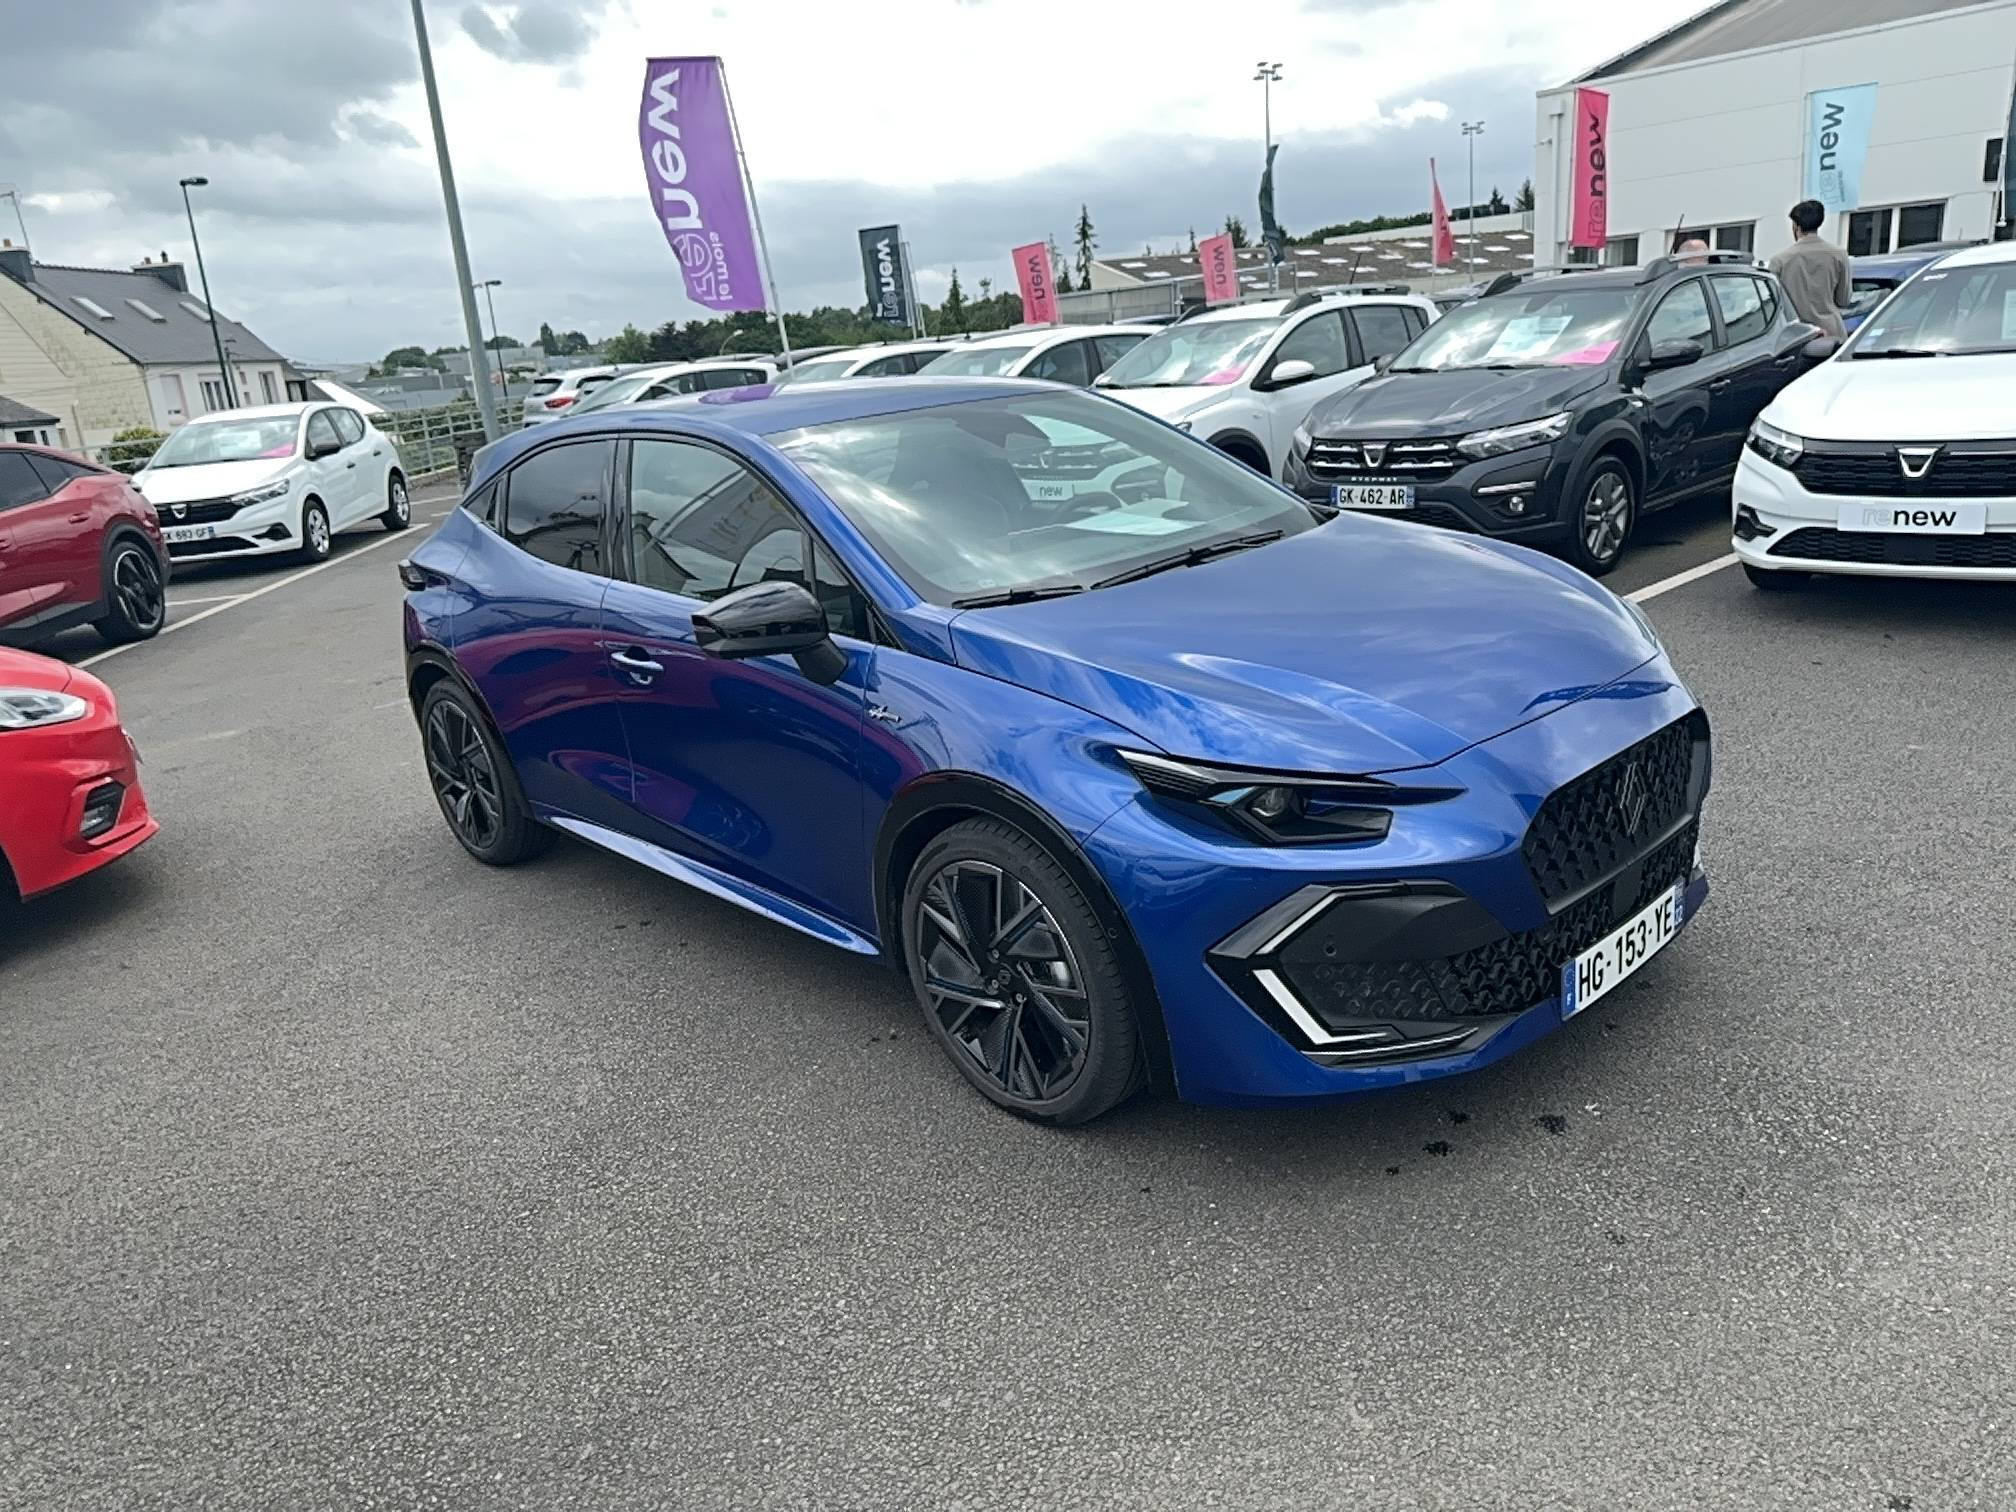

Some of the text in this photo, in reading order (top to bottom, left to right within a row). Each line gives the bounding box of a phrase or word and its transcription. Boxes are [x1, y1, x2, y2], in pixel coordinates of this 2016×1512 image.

[1587, 111, 1606, 241] renew
[1339, 487, 1405, 505] GK-462-AR
[1861, 508, 1957, 527] renew
[1579, 896, 1673, 1003] HG-153-YE
